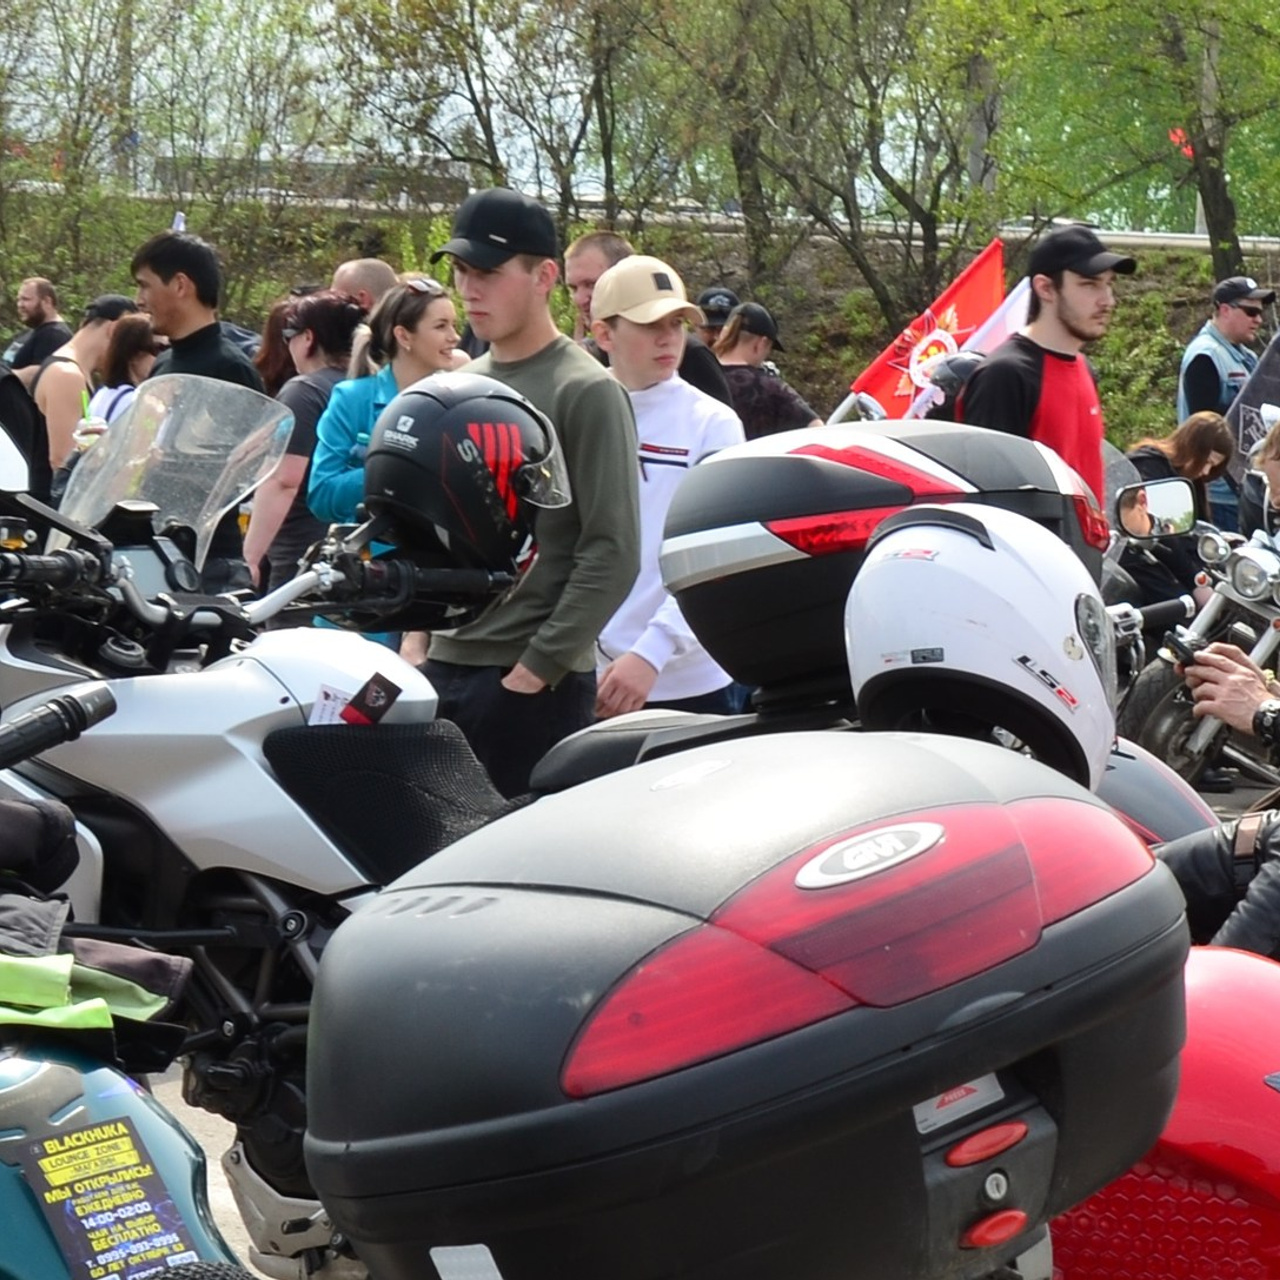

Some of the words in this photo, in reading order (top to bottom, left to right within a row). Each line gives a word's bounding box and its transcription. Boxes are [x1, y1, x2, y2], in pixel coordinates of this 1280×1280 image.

[43, 1122, 128, 1153] BLACKHUKA
[50, 1149, 89, 1168] LOUNGE
[96, 1143, 121, 1156] ZONE
[44, 1186, 72, 1204] МЫ
